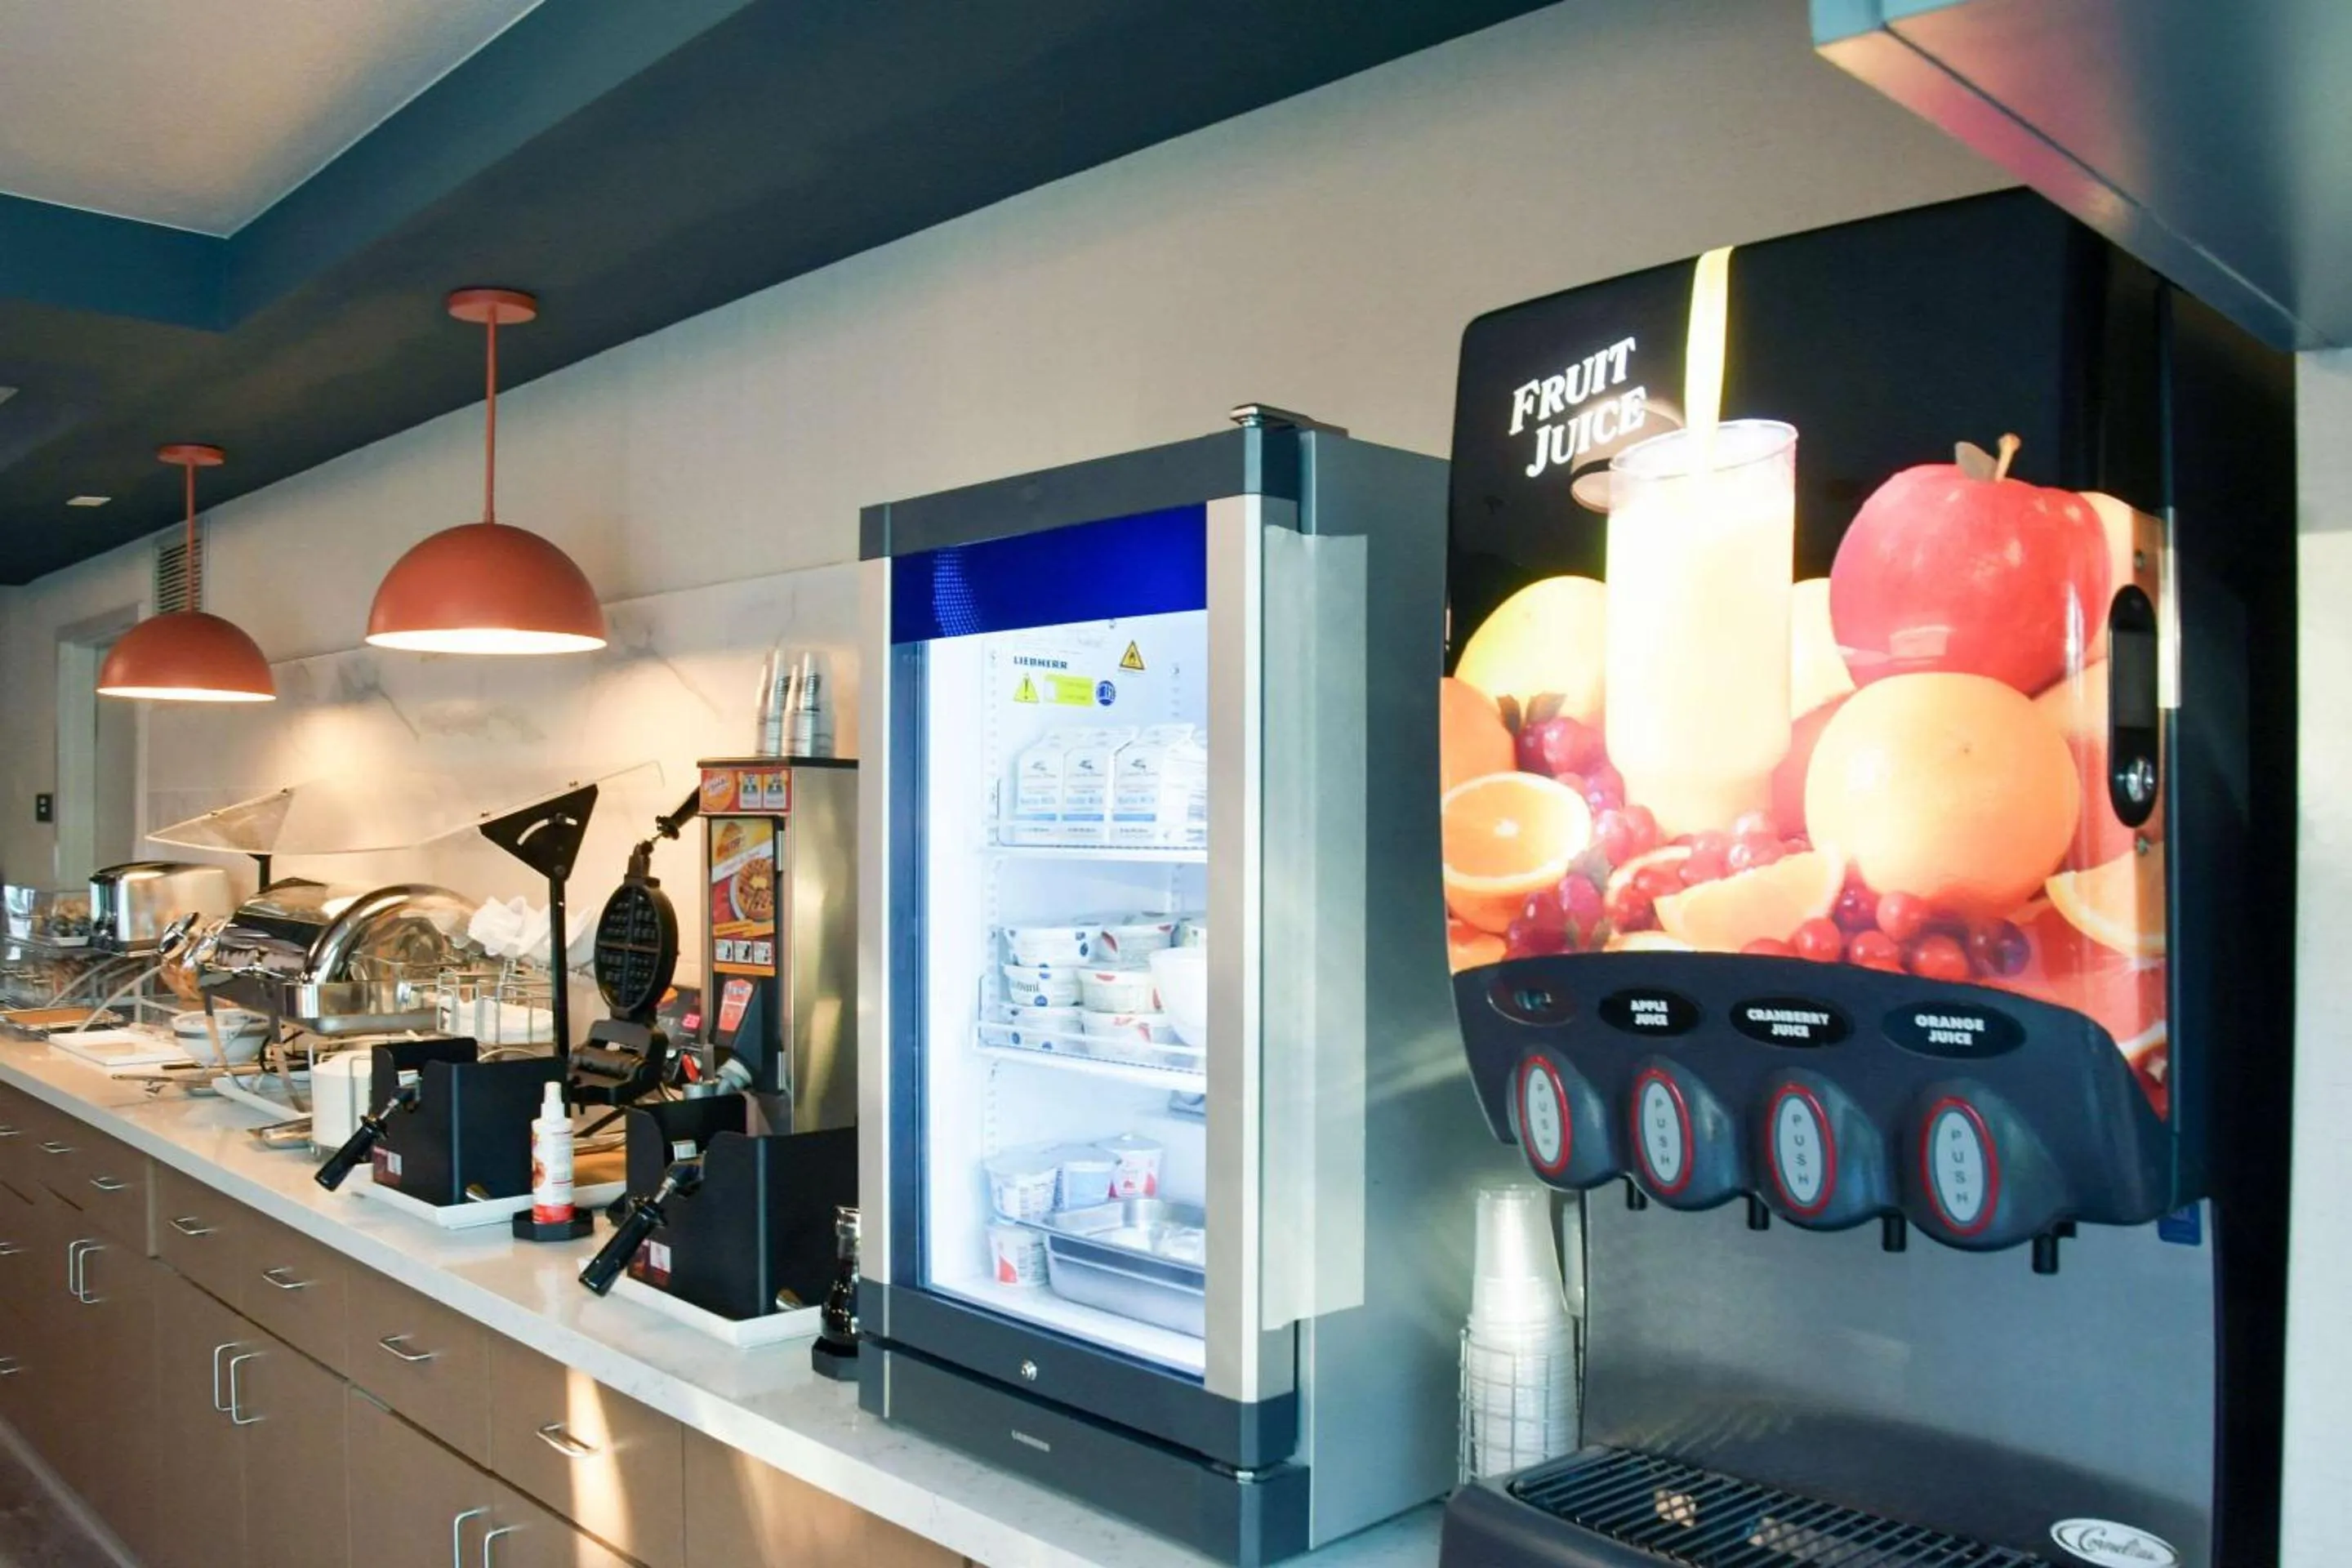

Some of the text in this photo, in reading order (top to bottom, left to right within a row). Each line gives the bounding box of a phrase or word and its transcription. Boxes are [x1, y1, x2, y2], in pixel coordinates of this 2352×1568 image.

[1508, 336, 1637, 435] FRUIT
[1526, 385, 1646, 478] JUICE
[1013, 656, 1067, 669] LIEBHERR
[1630, 1000, 1668, 1013] APPLE
[1635, 1013, 1669, 1027] JUICE
[1747, 1008, 1829, 1026] CRANBERRY
[1914, 1013, 1984, 1031] ORANGE
[1771, 1023, 1811, 1038] JUICE
[1928, 1030, 1973, 1045] JUICE
[1655, 1098, 1671, 1166] PUSH
[1792, 1113, 1810, 1187] PUSH
[1951, 1128, 1969, 1205] PUSH
